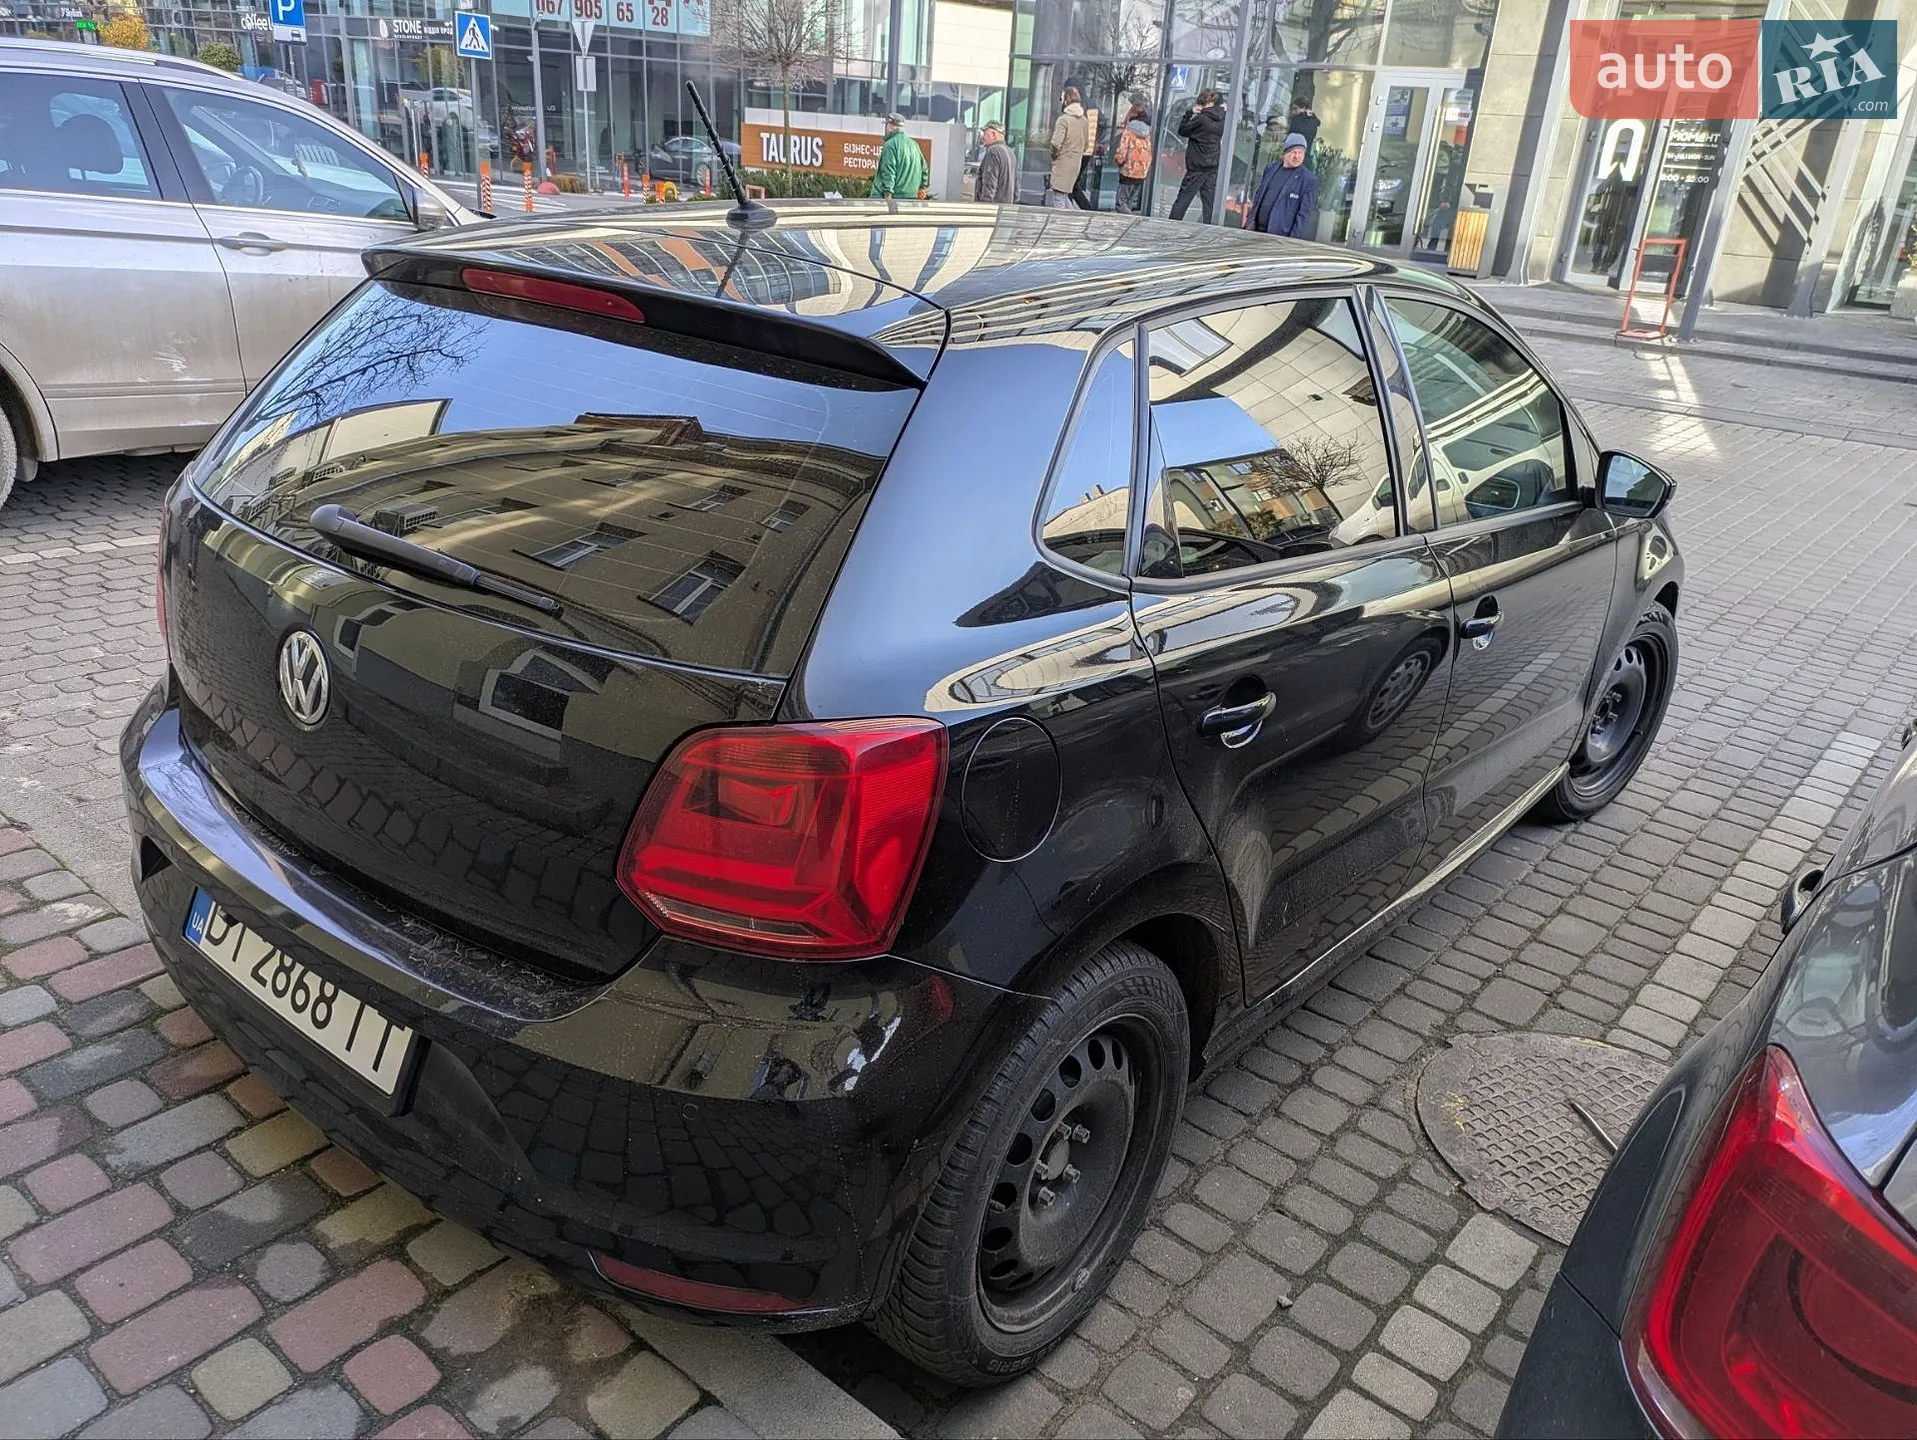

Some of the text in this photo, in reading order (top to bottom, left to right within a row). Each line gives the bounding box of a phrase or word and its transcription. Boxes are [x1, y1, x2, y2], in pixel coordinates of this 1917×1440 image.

[278, 0, 295, 21] P
[575, 0, 602, 20] 905
[616, 2, 634, 23] 65
[652, 6, 669, 27] 28
[393, 19, 423, 34] STONE
[192, 911, 204, 935] UA
[250, 946, 339, 1031] 2868
